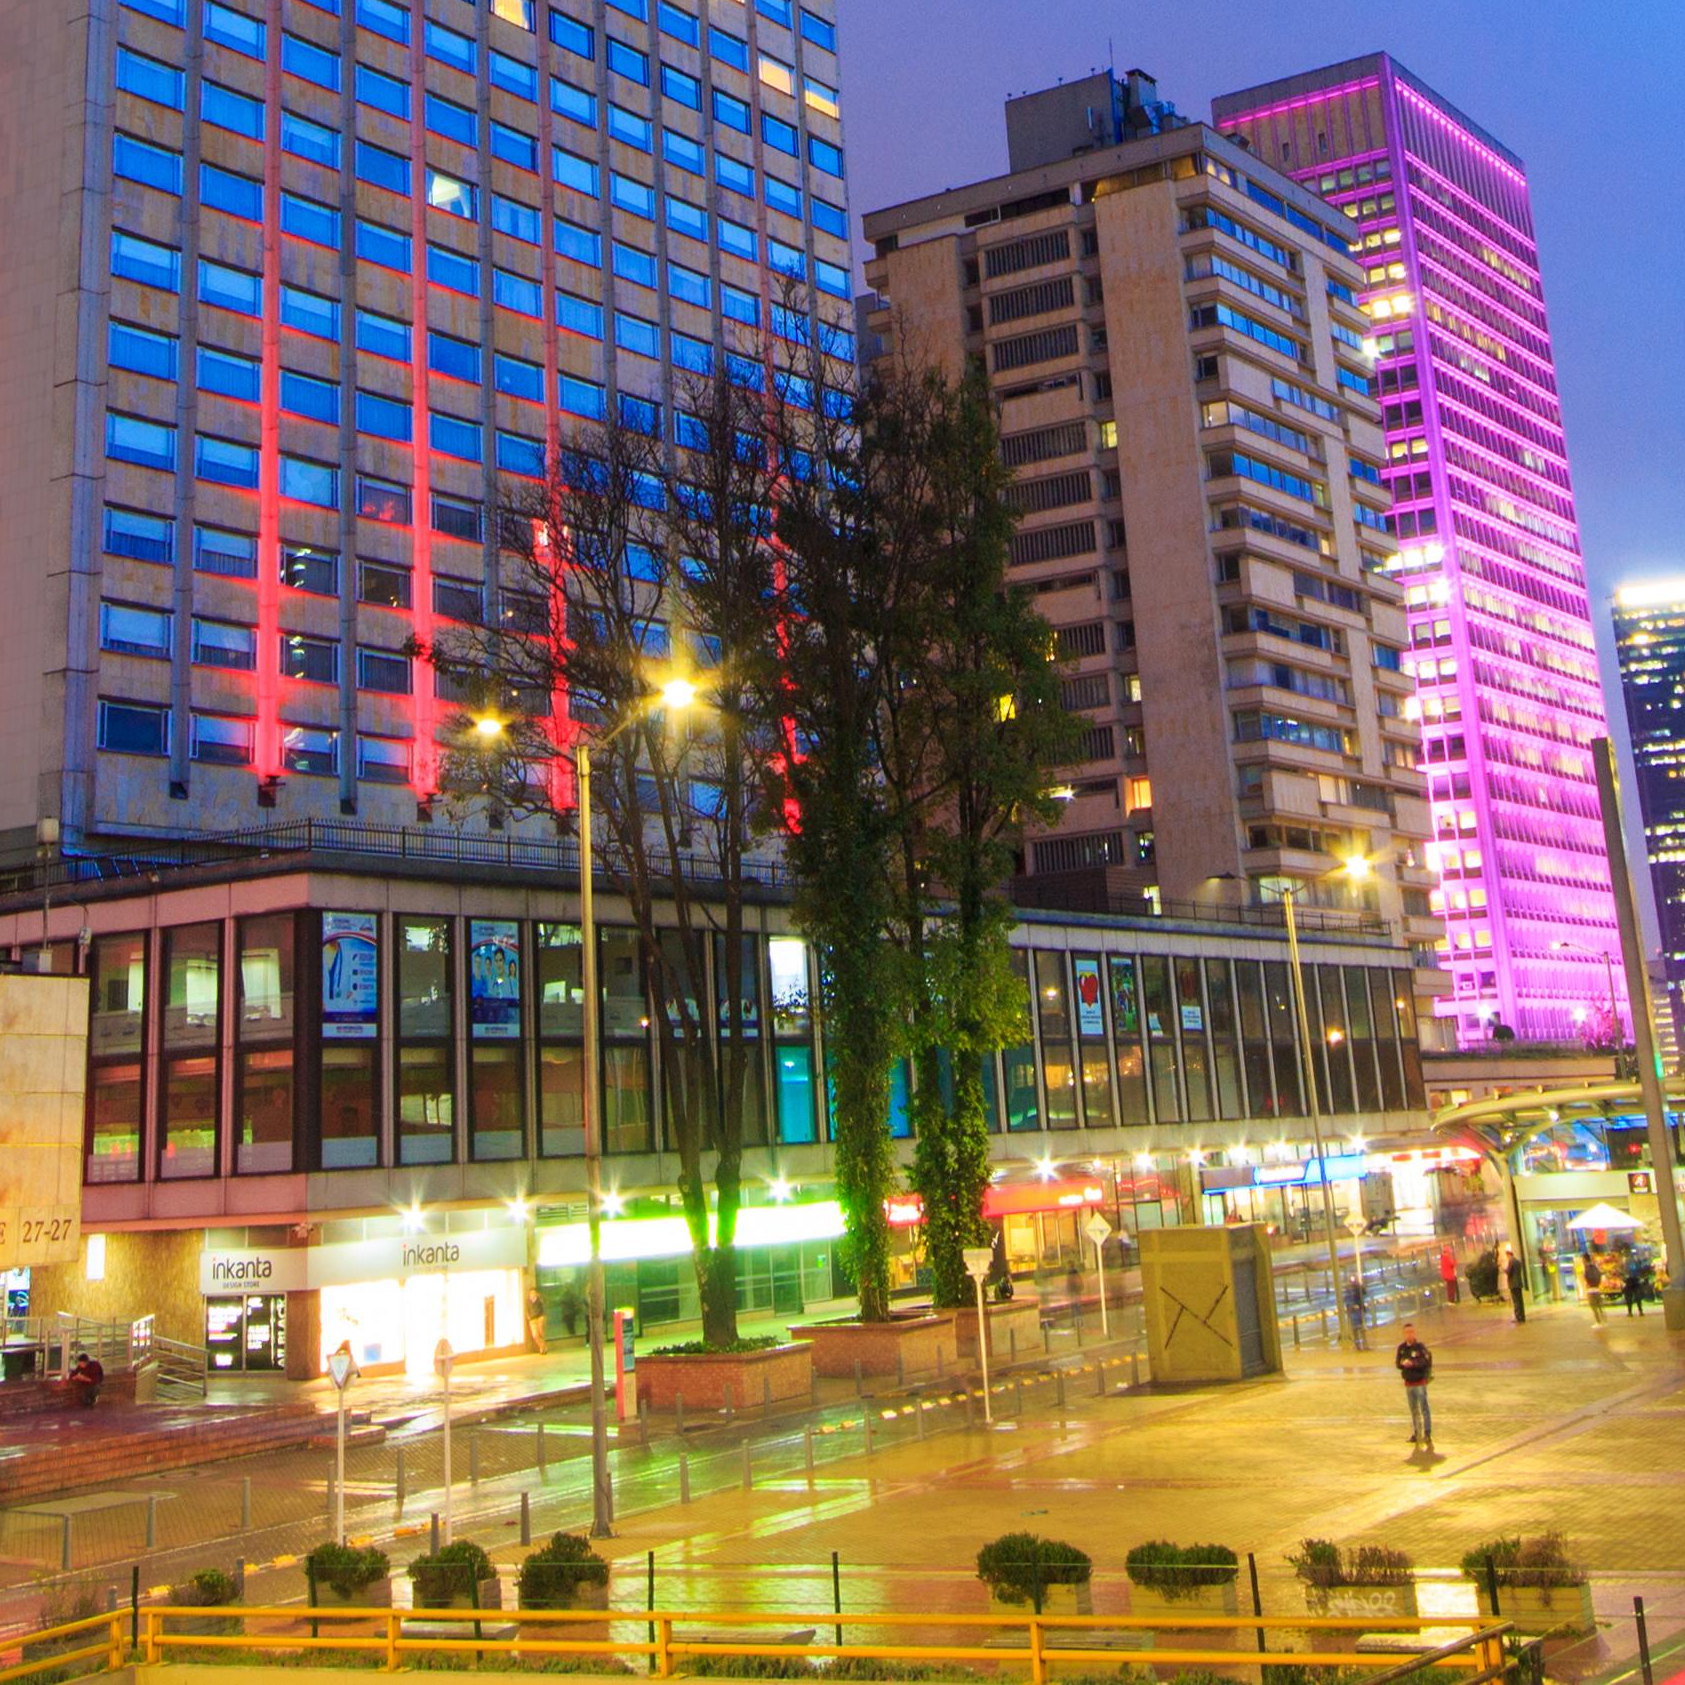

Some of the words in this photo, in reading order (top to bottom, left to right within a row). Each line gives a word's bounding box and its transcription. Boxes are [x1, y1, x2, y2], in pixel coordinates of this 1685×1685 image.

[22, 1219, 72, 1244] 27-27
[403, 1242, 459, 1266] inkanta
[212, 1256, 272, 1279] inkanta
